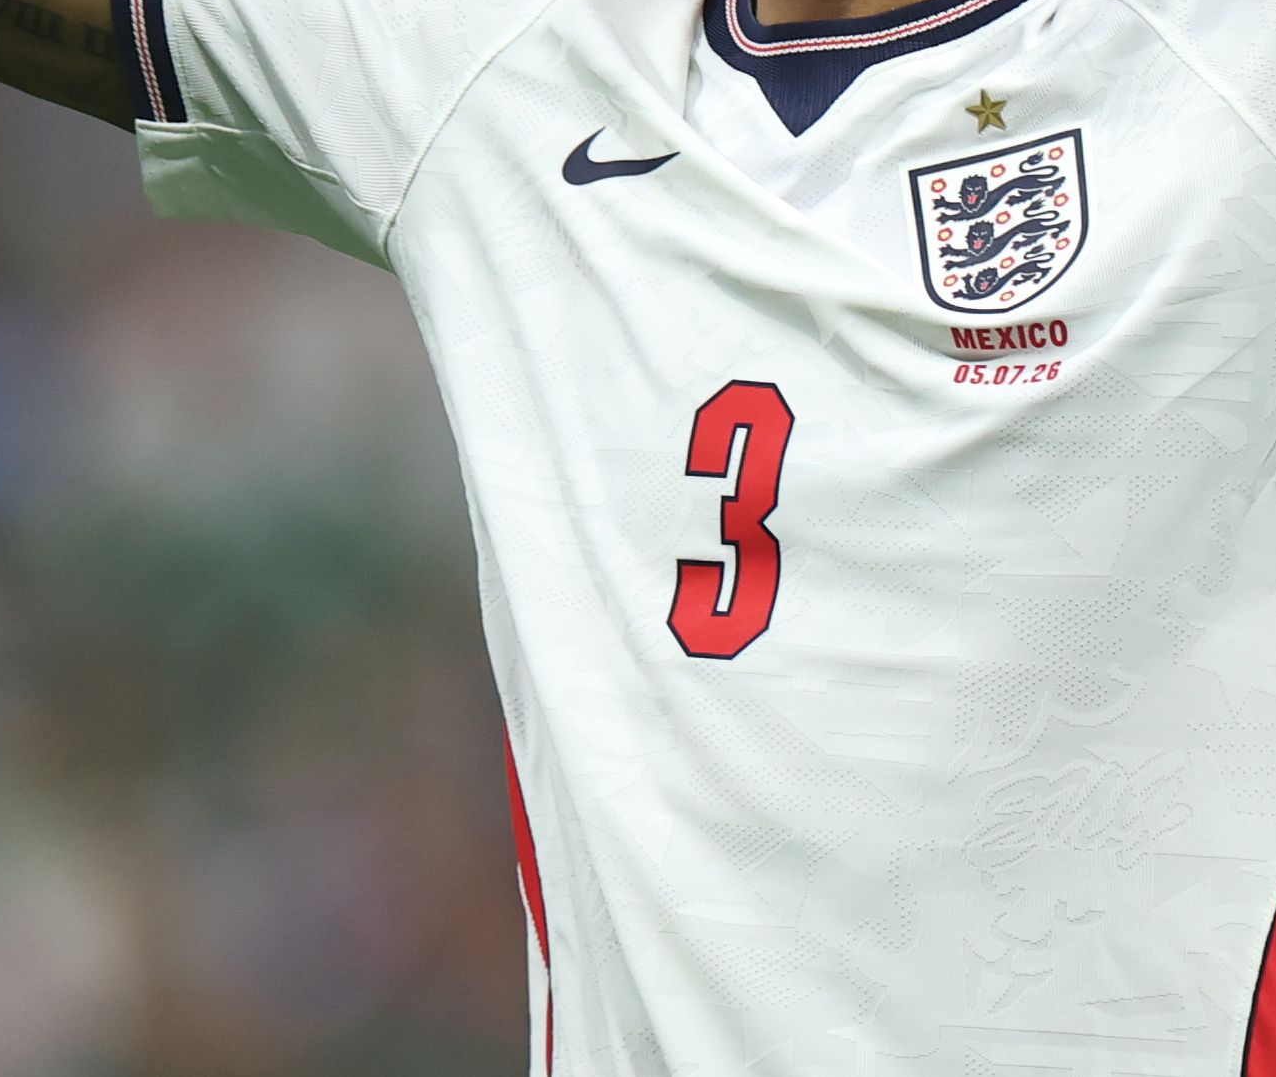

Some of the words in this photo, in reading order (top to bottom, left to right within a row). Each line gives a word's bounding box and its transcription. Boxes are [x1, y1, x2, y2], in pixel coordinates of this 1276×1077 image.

[951, 320, 1069, 350] MEXICO
[953, 361, 1063, 385] 05.07.26
[666, 379, 795, 660] 3
